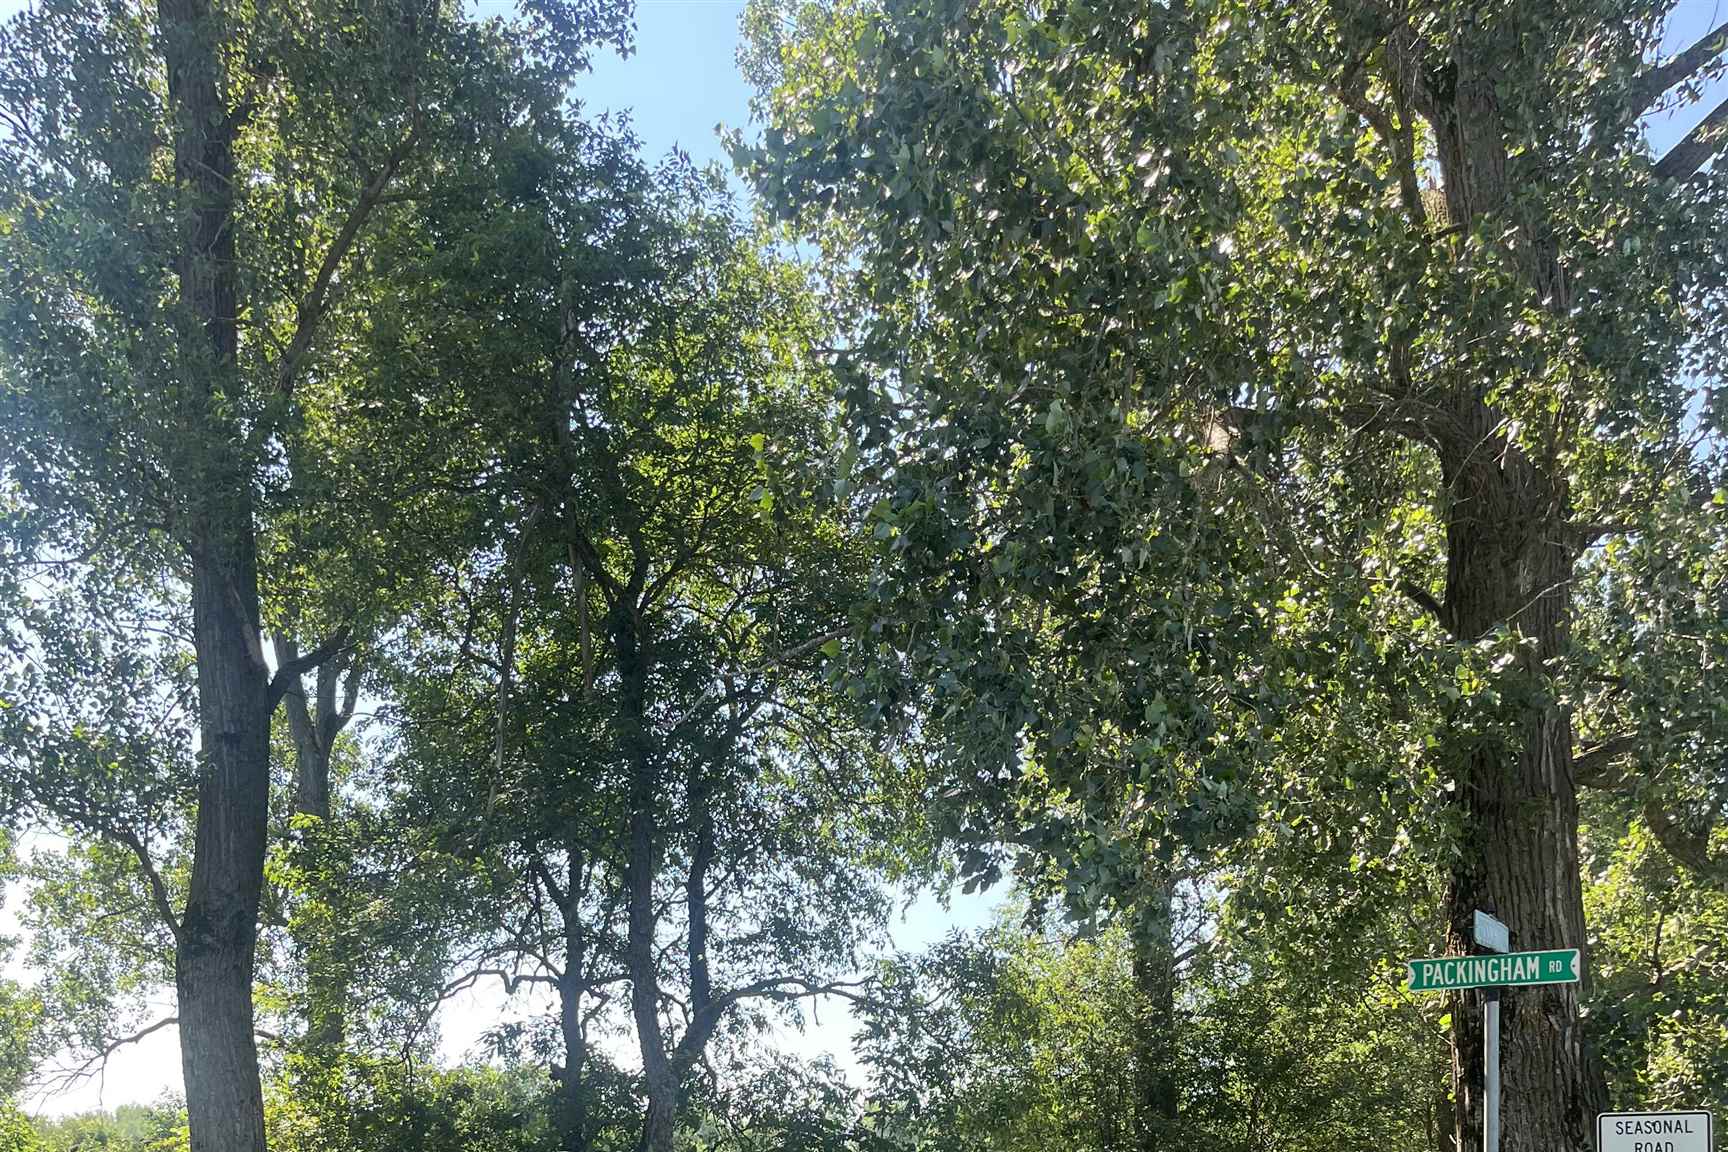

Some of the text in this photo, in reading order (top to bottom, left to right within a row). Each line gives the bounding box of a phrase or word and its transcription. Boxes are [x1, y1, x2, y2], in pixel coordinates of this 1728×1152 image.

[1423, 956, 1562, 986] PACKINGHAM RD
[1615, 1119, 1694, 1135] SEASONAL
